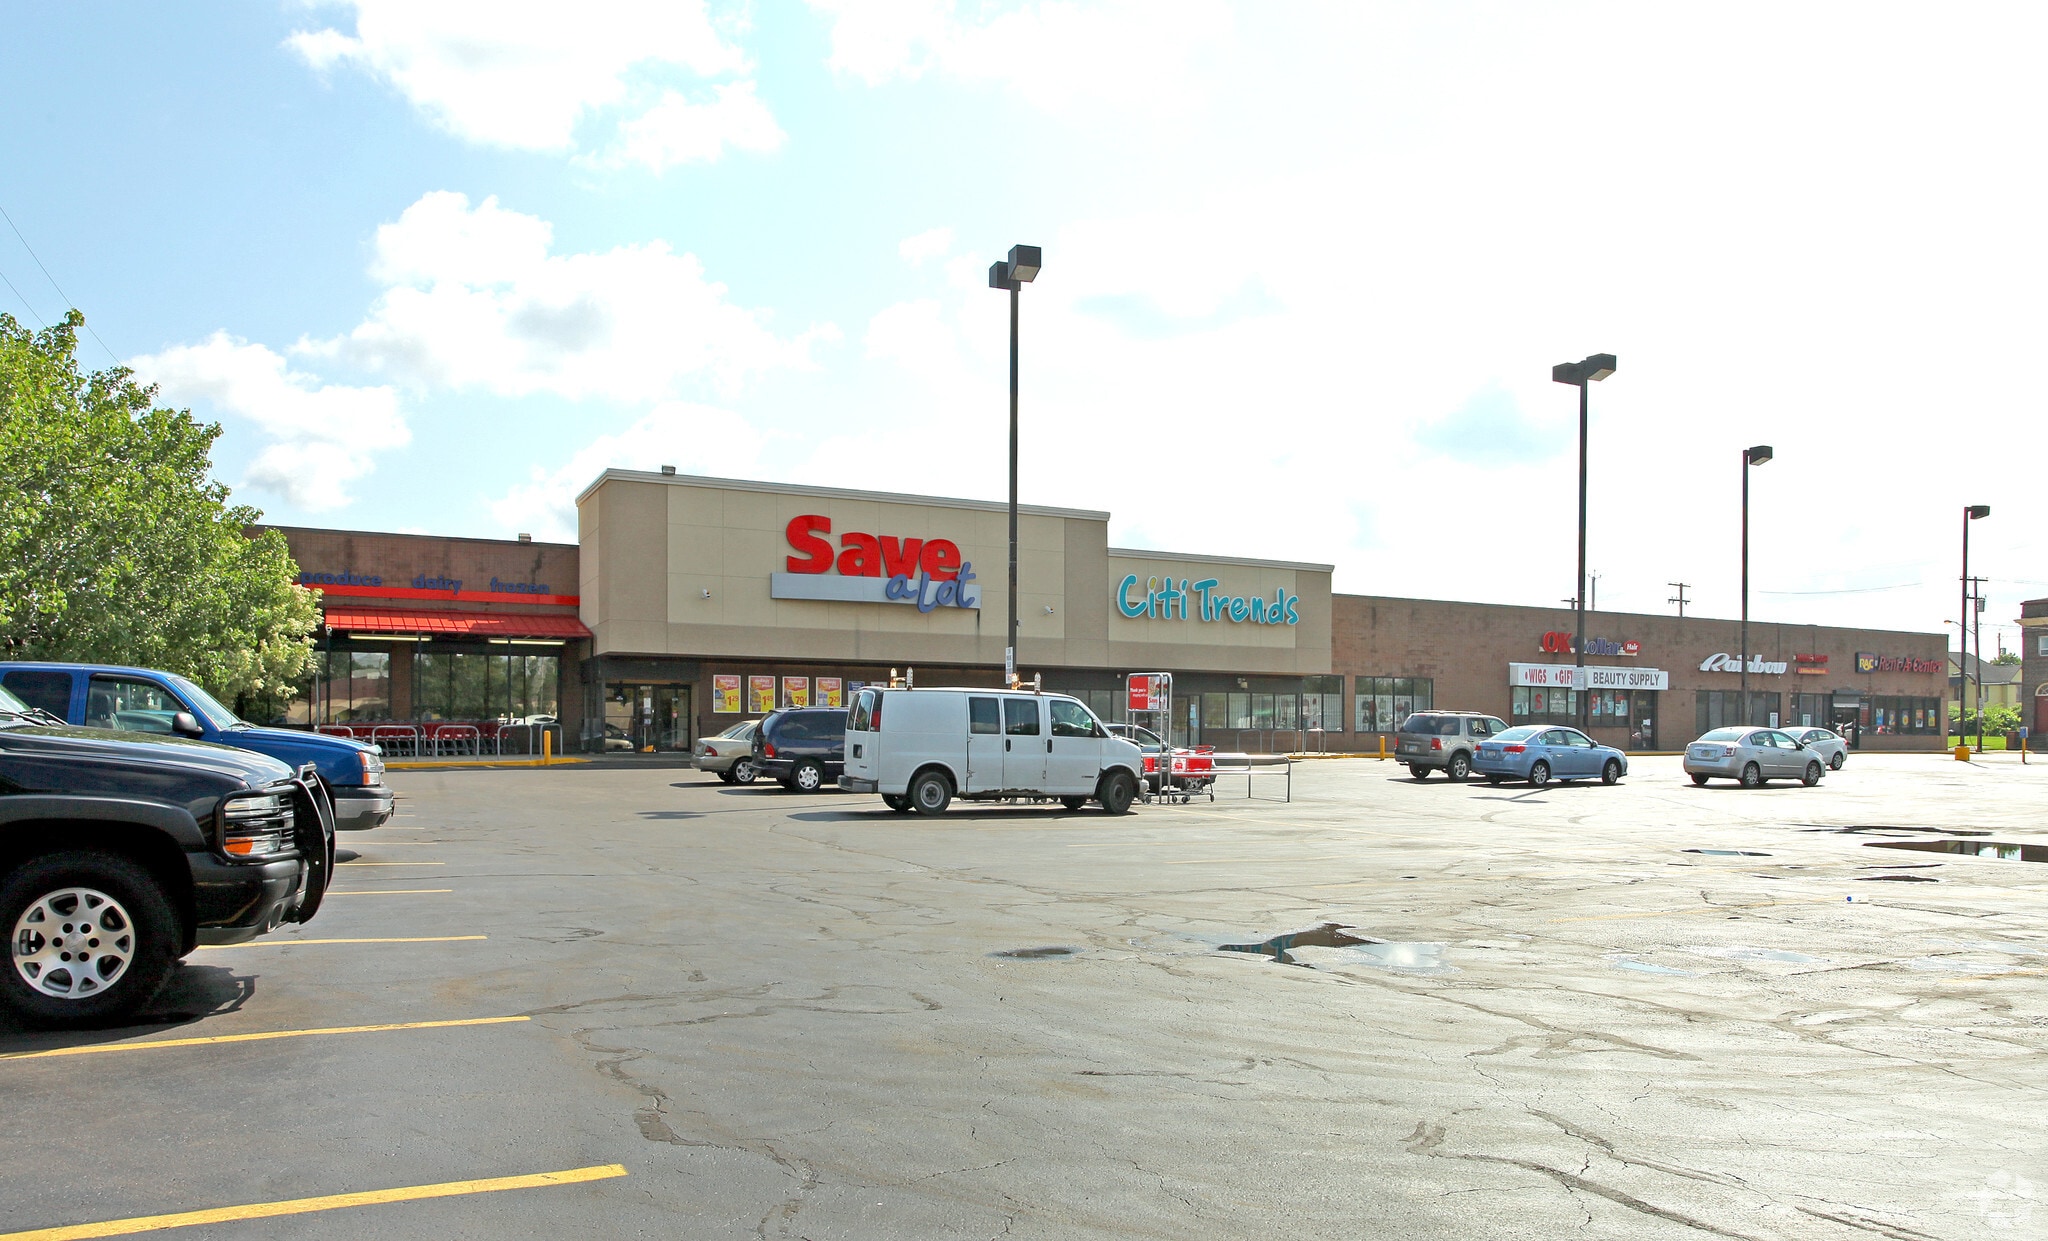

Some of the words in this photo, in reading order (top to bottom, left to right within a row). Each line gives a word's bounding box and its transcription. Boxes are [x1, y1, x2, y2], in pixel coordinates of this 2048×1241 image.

[785, 514, 962, 582] Save
[300, 567, 383, 588] produce
[412, 573, 463, 595] dairy
[489, 576, 550, 594] frozen
[1117, 573, 1189, 620] Citi
[1192, 577, 1300, 625] Trends
[1543, 631, 1571, 653] OK
[1626, 642, 1638, 650] Hair
[1528, 668, 1547, 684] WIGS
[1593, 671, 1627, 685] BEAUTY
[1628, 673, 1660, 687] SUPPLY
